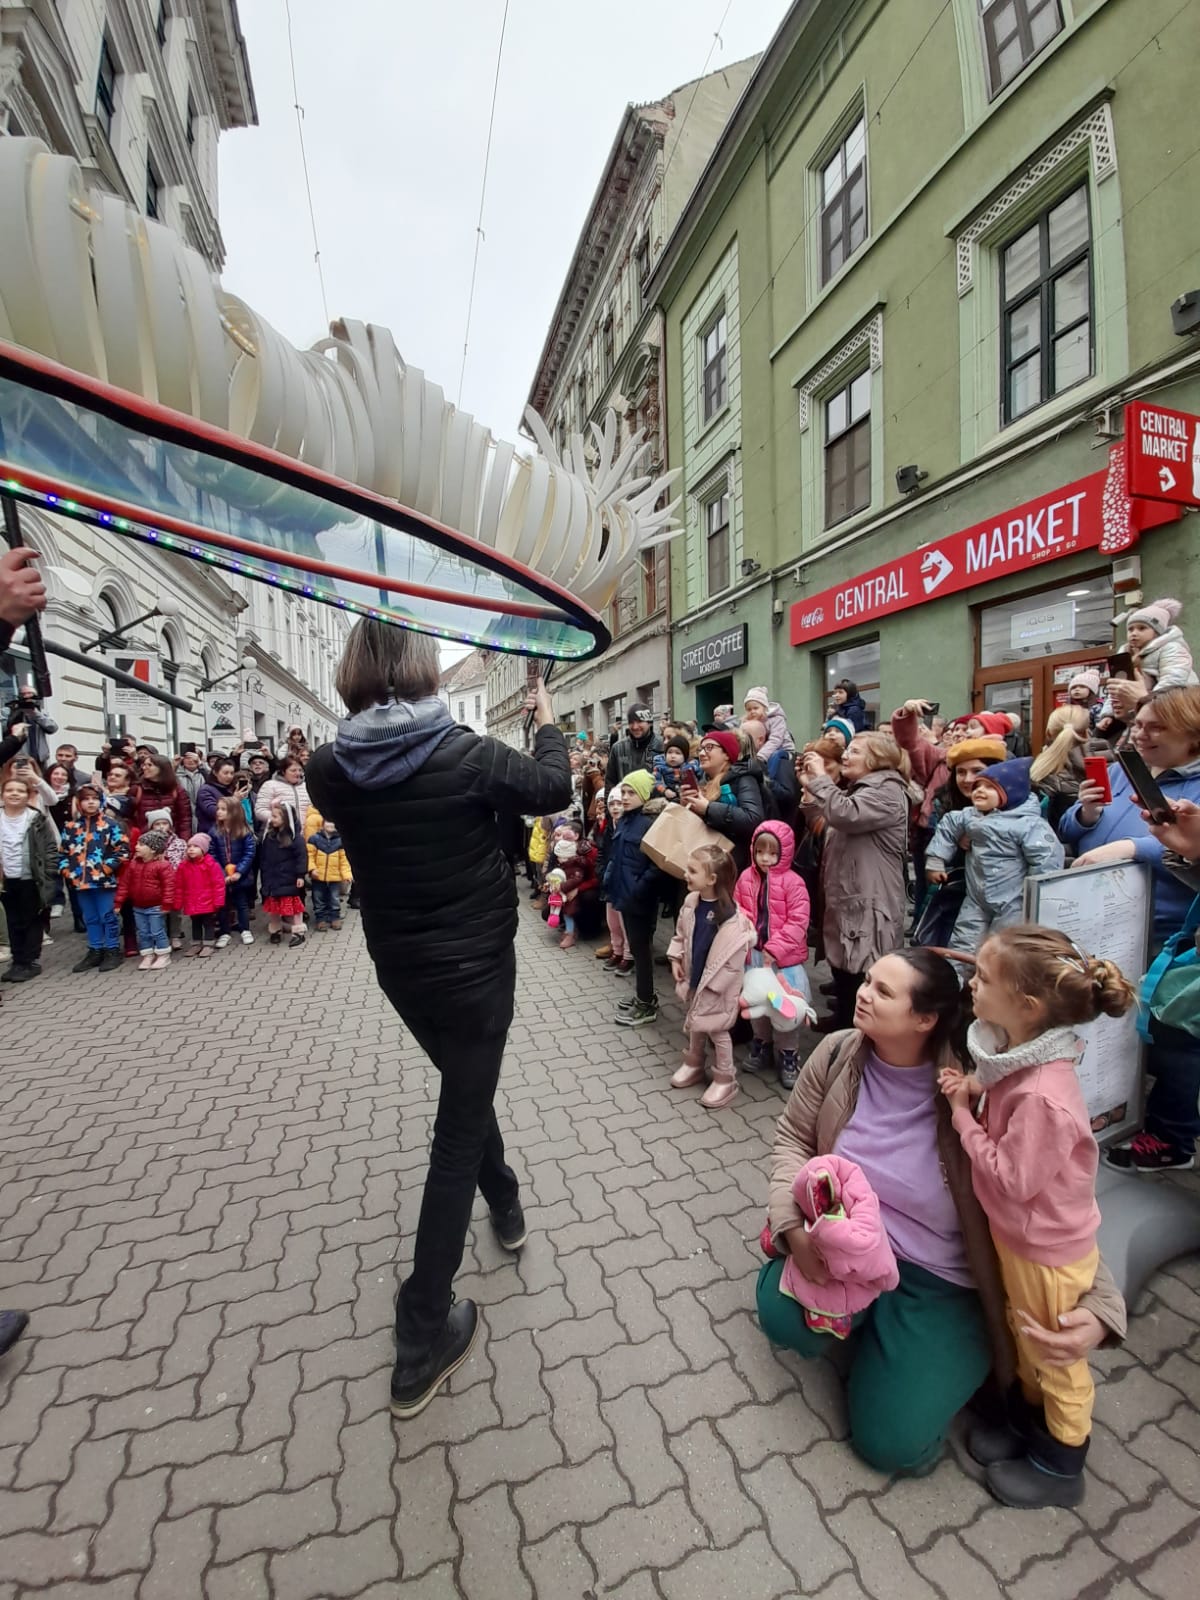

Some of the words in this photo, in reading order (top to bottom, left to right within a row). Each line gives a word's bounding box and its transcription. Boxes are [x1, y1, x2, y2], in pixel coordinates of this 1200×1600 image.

[1140, 410, 1189, 440] CENTRAL
[1142, 433, 1188, 463] MARKET
[835, 567, 909, 621] CENTRAL
[966, 491, 1087, 574] MARKET
[1031, 548, 1051, 560] SHOP
[1056, 544, 1061, 553] &
[1066, 540, 1077, 549] GO
[682, 645, 706, 670] STREET
[707, 630, 743, 660] COFFEE
